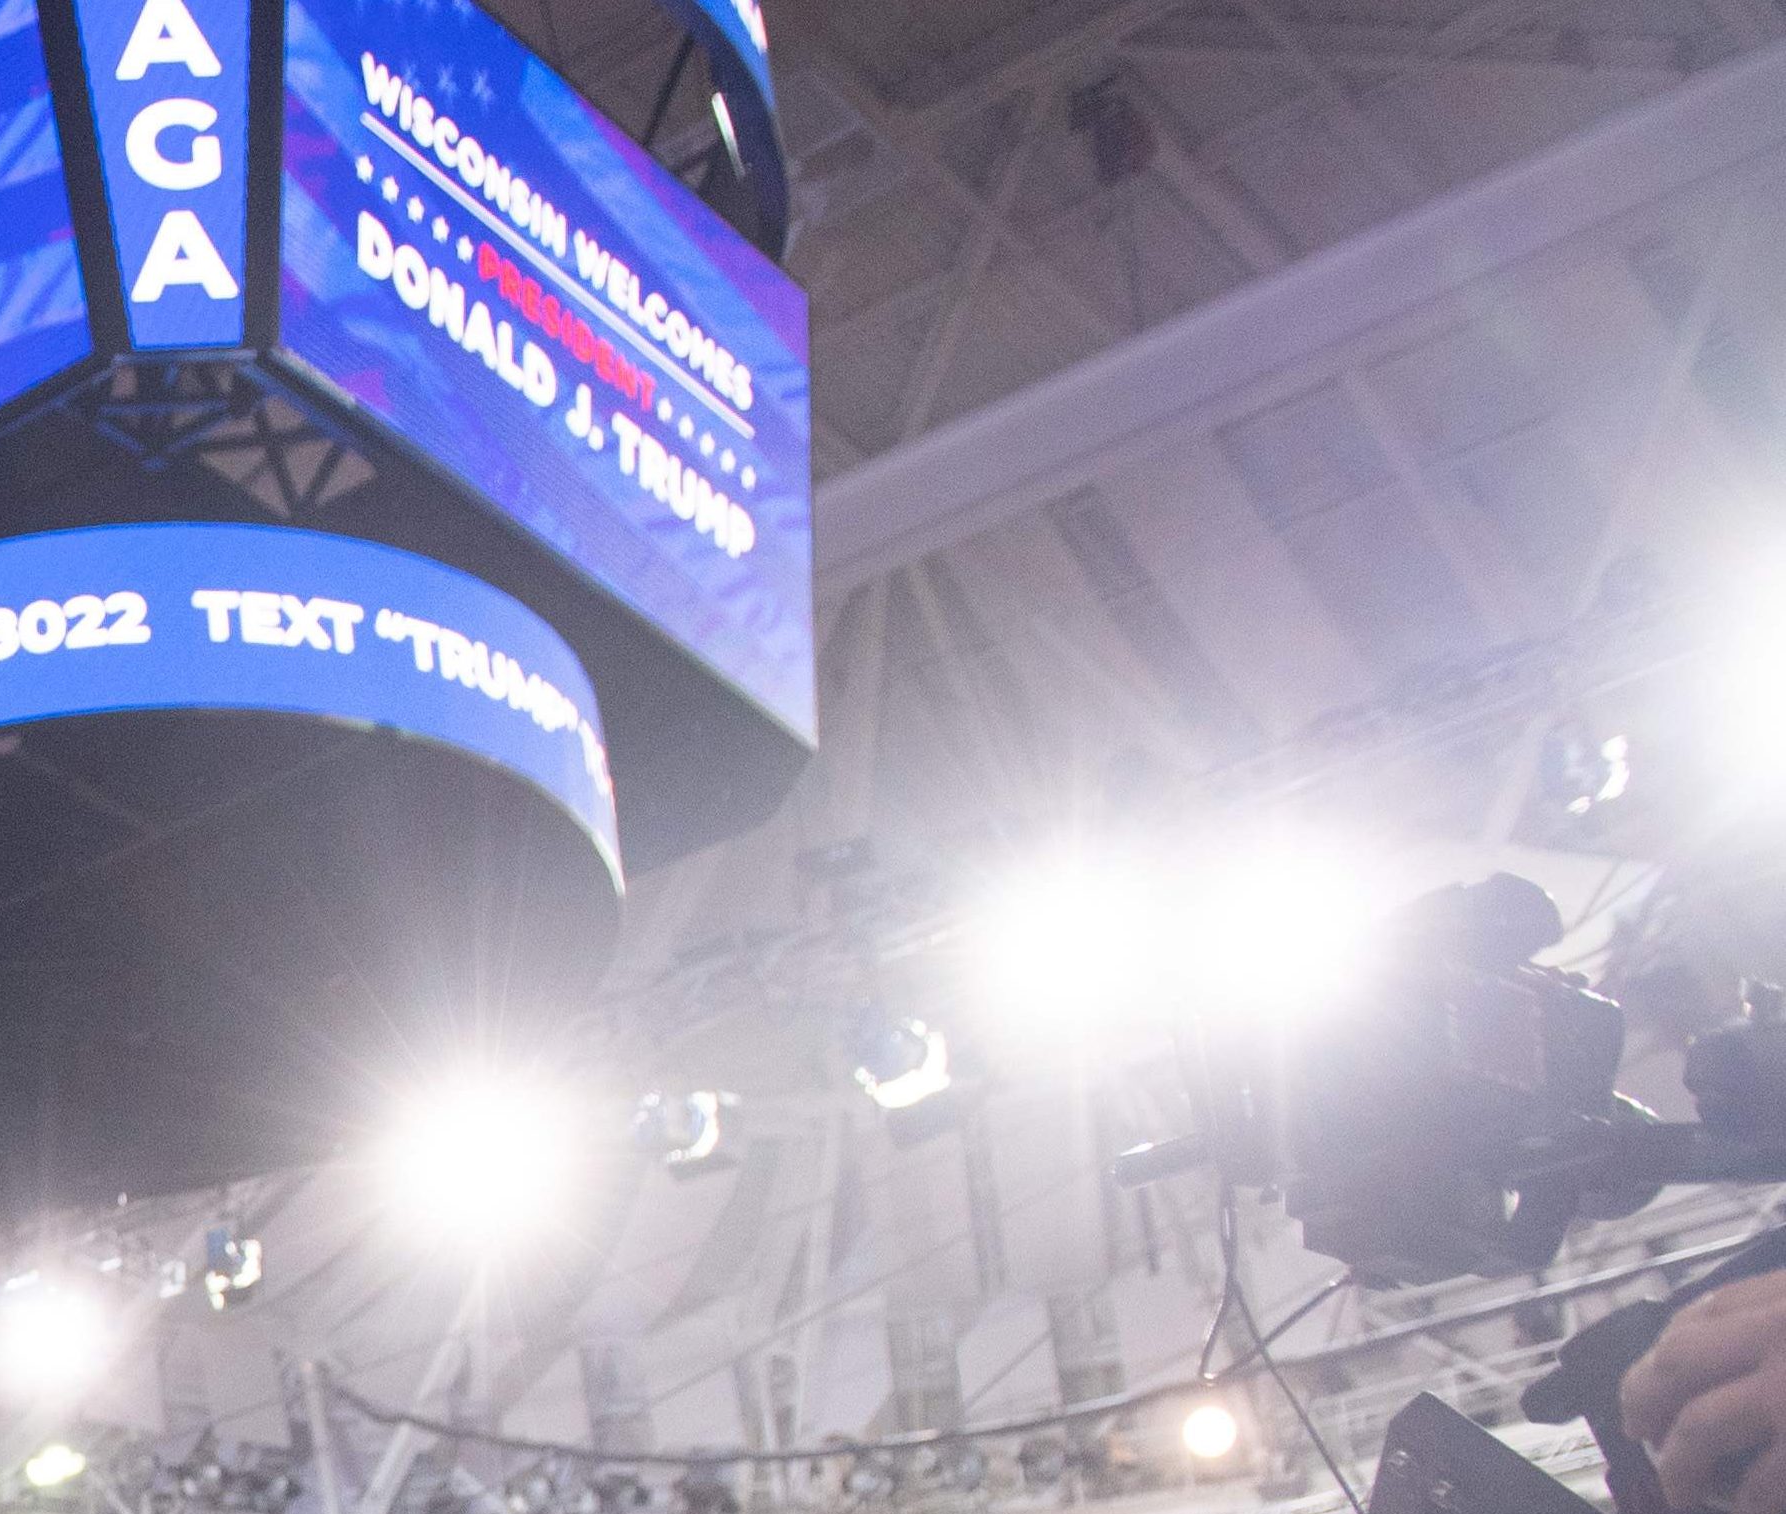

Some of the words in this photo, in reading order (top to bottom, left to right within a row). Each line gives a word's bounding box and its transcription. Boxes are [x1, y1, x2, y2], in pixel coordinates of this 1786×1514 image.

[361, 51, 568, 258] WISCONSIN
[573, 229, 755, 411] WELCOMES
[476, 241, 658, 412] PRESIDENT
[357, 210, 558, 408] DONALD
[565, 383, 605, 451] J.
[611, 411, 757, 558] TRUMP
[190, 590, 364, 655] TEXT
